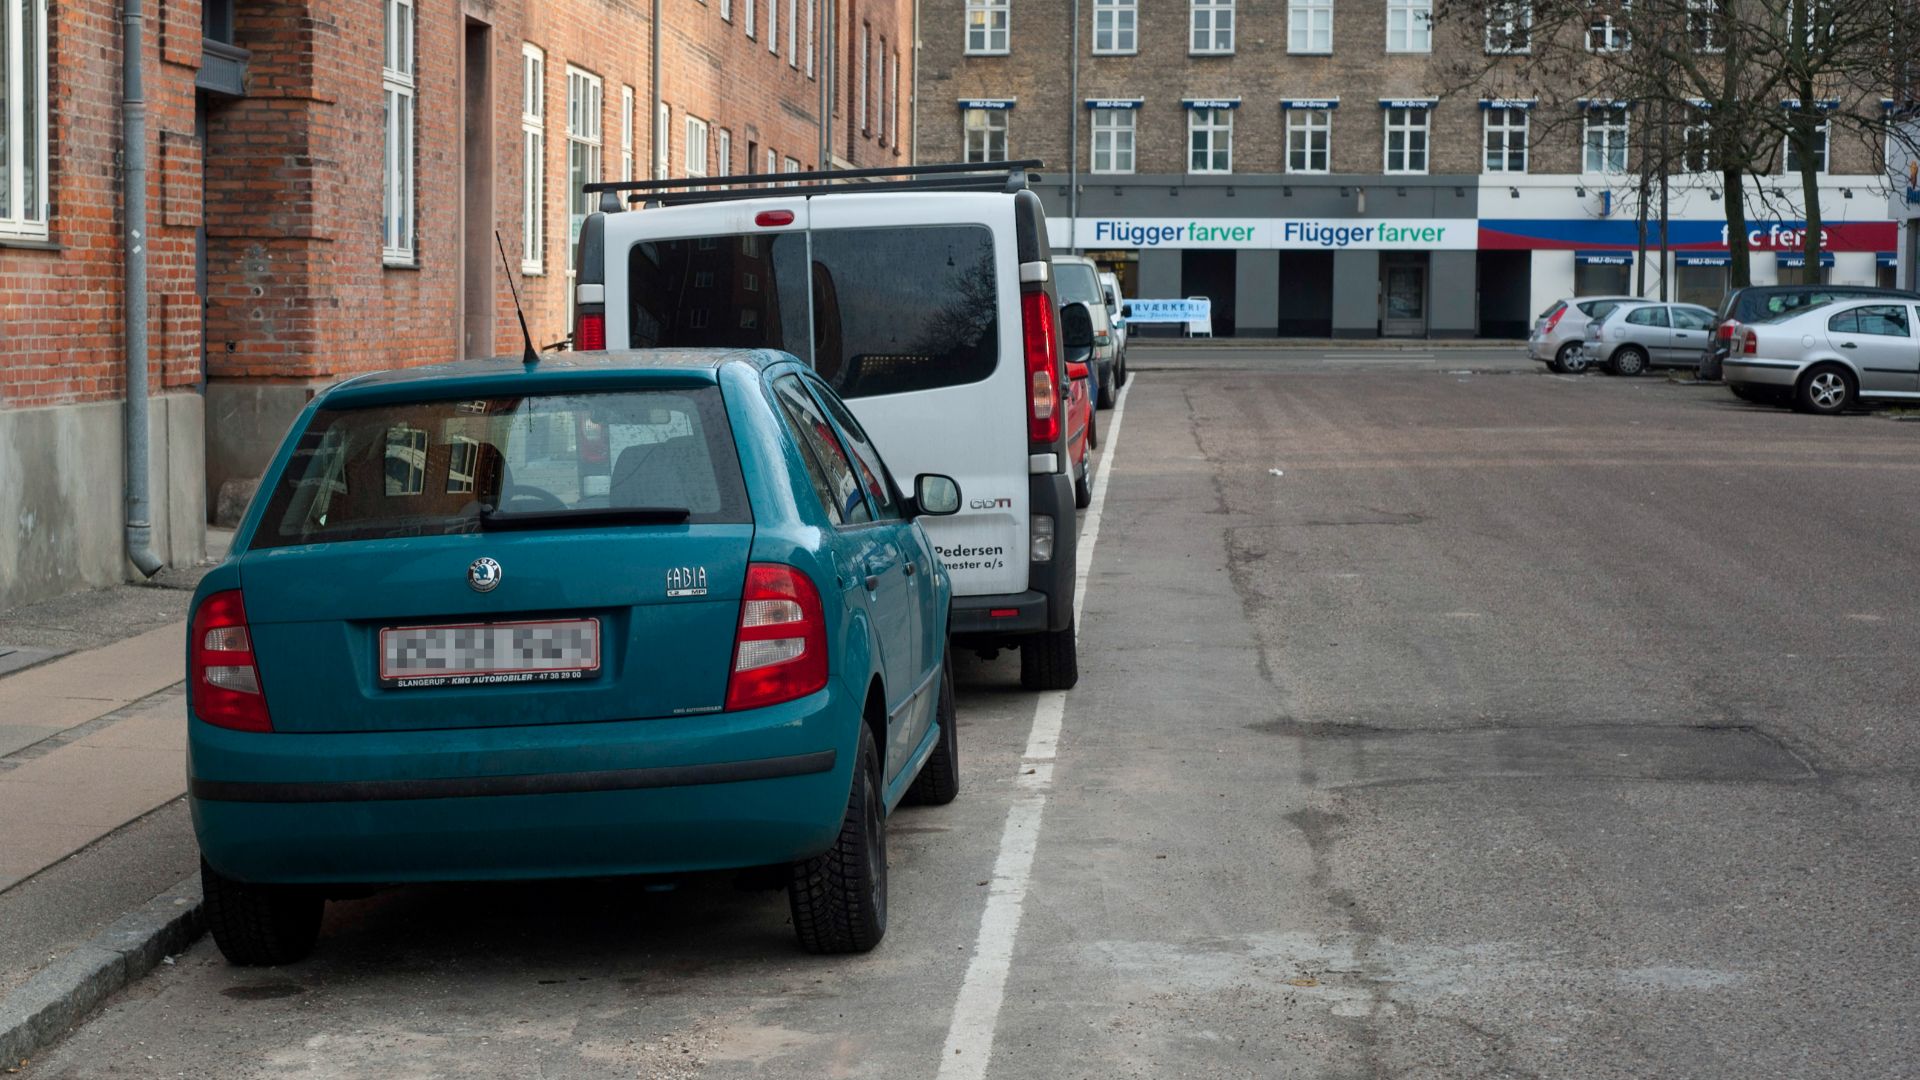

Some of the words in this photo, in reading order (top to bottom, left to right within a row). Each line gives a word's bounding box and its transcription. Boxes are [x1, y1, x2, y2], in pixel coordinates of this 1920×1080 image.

[1096, 221, 1184, 245] Flügger
[1188, 222, 1255, 241] farver
[1284, 222, 1374, 246] Flügger
[1377, 223, 1445, 242] farver
[1721, 224, 1761, 246] fc
[1770, 224, 1828, 247] fere
[1587, 257, 1625, 265] HMJ-Group
[1687, 258, 1725, 266] HMJ-Group
[1135, 303, 1204, 312] RVÆRKERI
[934, 544, 1003, 557] Pedersen
[984, 558, 1003, 570] a/s
[667, 566, 707, 589] FABIA
[398, 678, 445, 687] SLANGERUP
[452, 676, 470, 685] KMG
[473, 673, 533, 684] AUTOMOBILER
